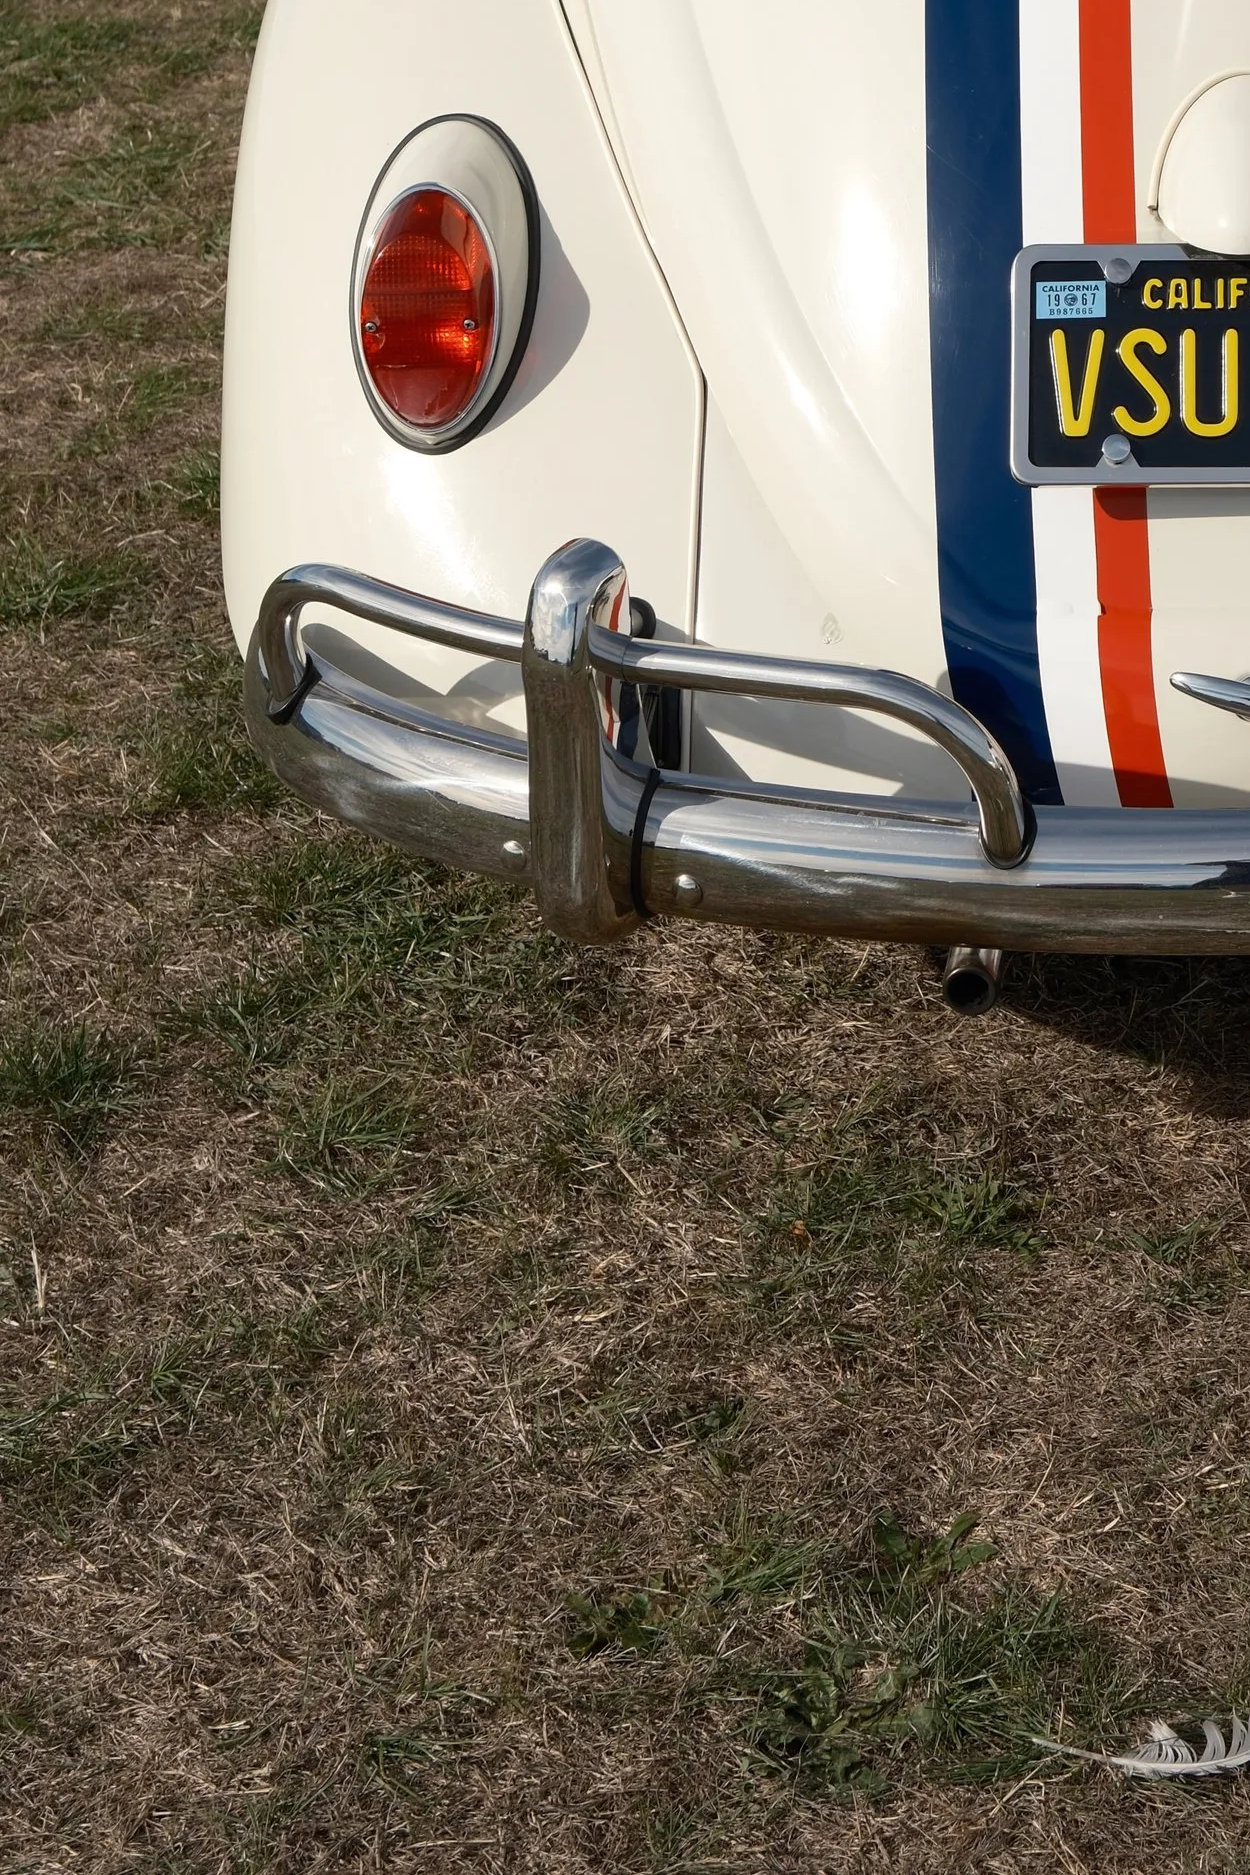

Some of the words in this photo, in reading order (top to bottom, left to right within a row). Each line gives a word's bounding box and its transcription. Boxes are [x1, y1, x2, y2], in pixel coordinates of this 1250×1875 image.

[1042, 284, 1100, 293] CALIFORNIA
[1047, 293, 1060, 307] 19
[1081, 292, 1097, 306] 67
[1049, 328, 1239, 437] VSU
